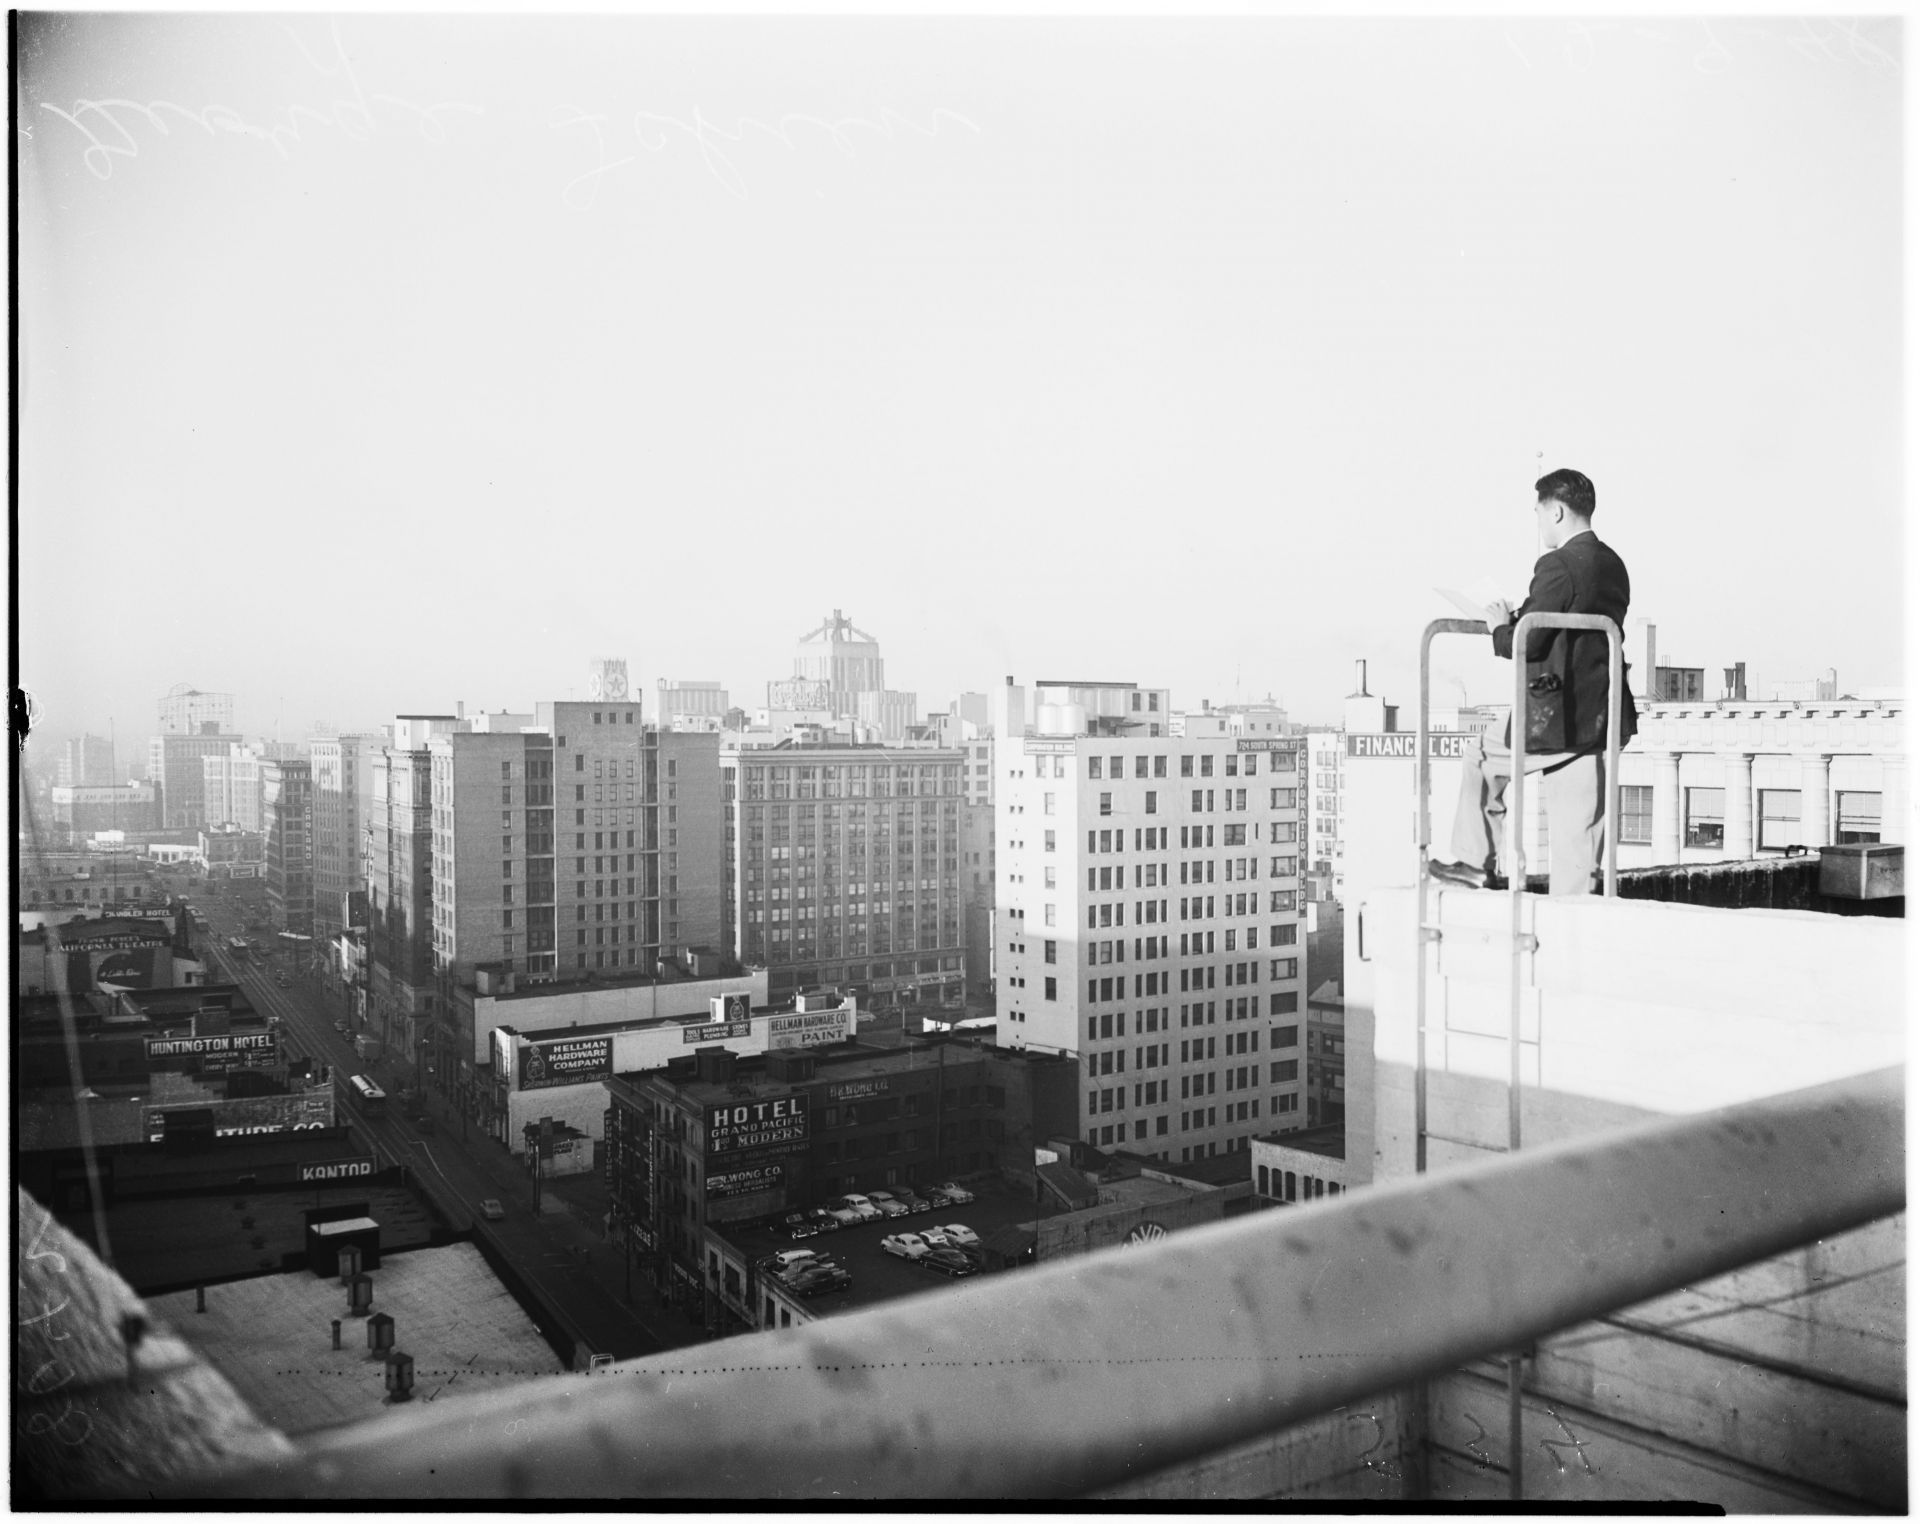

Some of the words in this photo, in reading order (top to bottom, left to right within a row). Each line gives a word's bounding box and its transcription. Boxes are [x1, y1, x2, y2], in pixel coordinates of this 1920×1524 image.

[146, 909, 172, 917] HOTEL
[770, 1018, 803, 1032] HELLMAN
[804, 1014, 835, 1028] HARDWARE
[801, 1030, 844, 1042] PAINT
[150, 1039, 229, 1055] HUNTINGTON
[233, 1035, 274, 1049] HOTEL
[553, 1041, 608, 1053] HELLMAN
[549, 1048, 608, 1062] HARDWARE
[553, 1057, 608, 1070] COMPANY
[714, 1098, 803, 1127] HOTEL
[711, 1122, 758, 1138] GRAND
[761, 1115, 806, 1130] PACIFIC
[737, 1125, 804, 1148] MODERN
